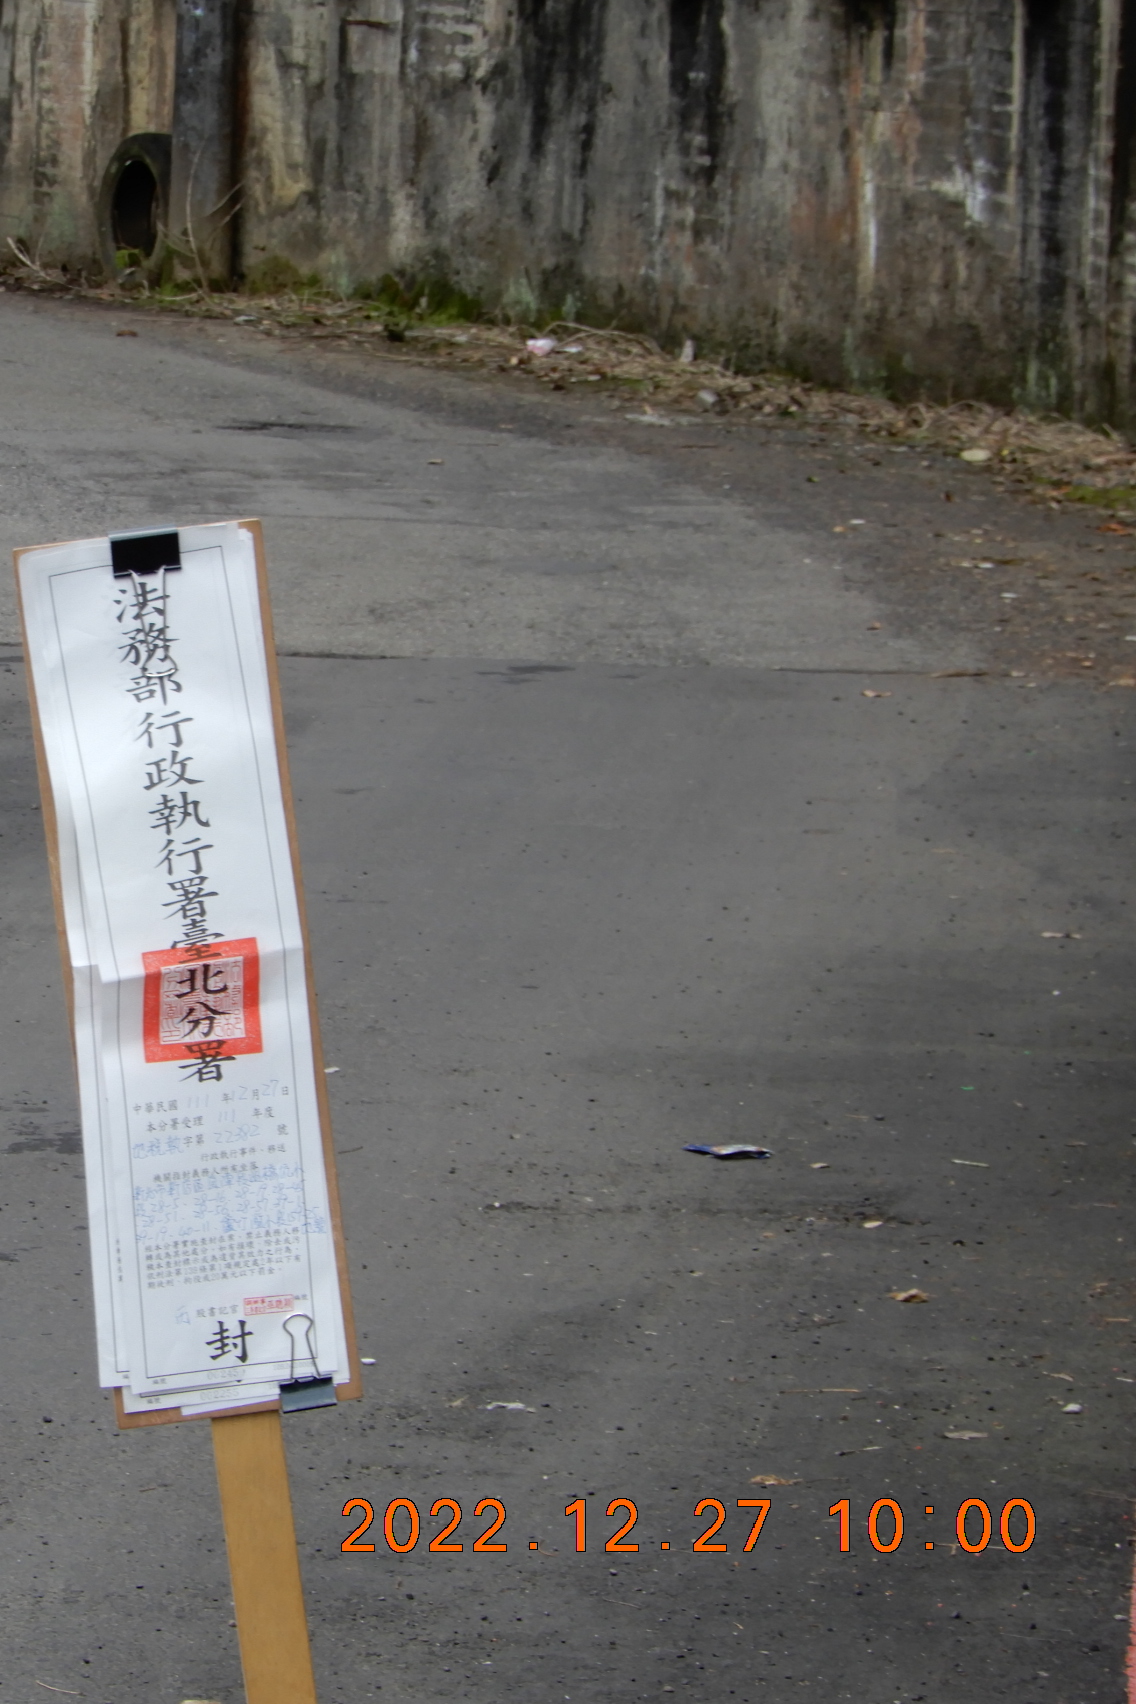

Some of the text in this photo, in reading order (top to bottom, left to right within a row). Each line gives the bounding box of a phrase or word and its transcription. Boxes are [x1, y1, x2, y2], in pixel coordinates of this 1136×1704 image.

[112, 581, 238, 1084] 法務部行政執行署臺北分署
[133, 1099, 178, 1114] 中華民國
[205, 1320, 254, 1363] 封
